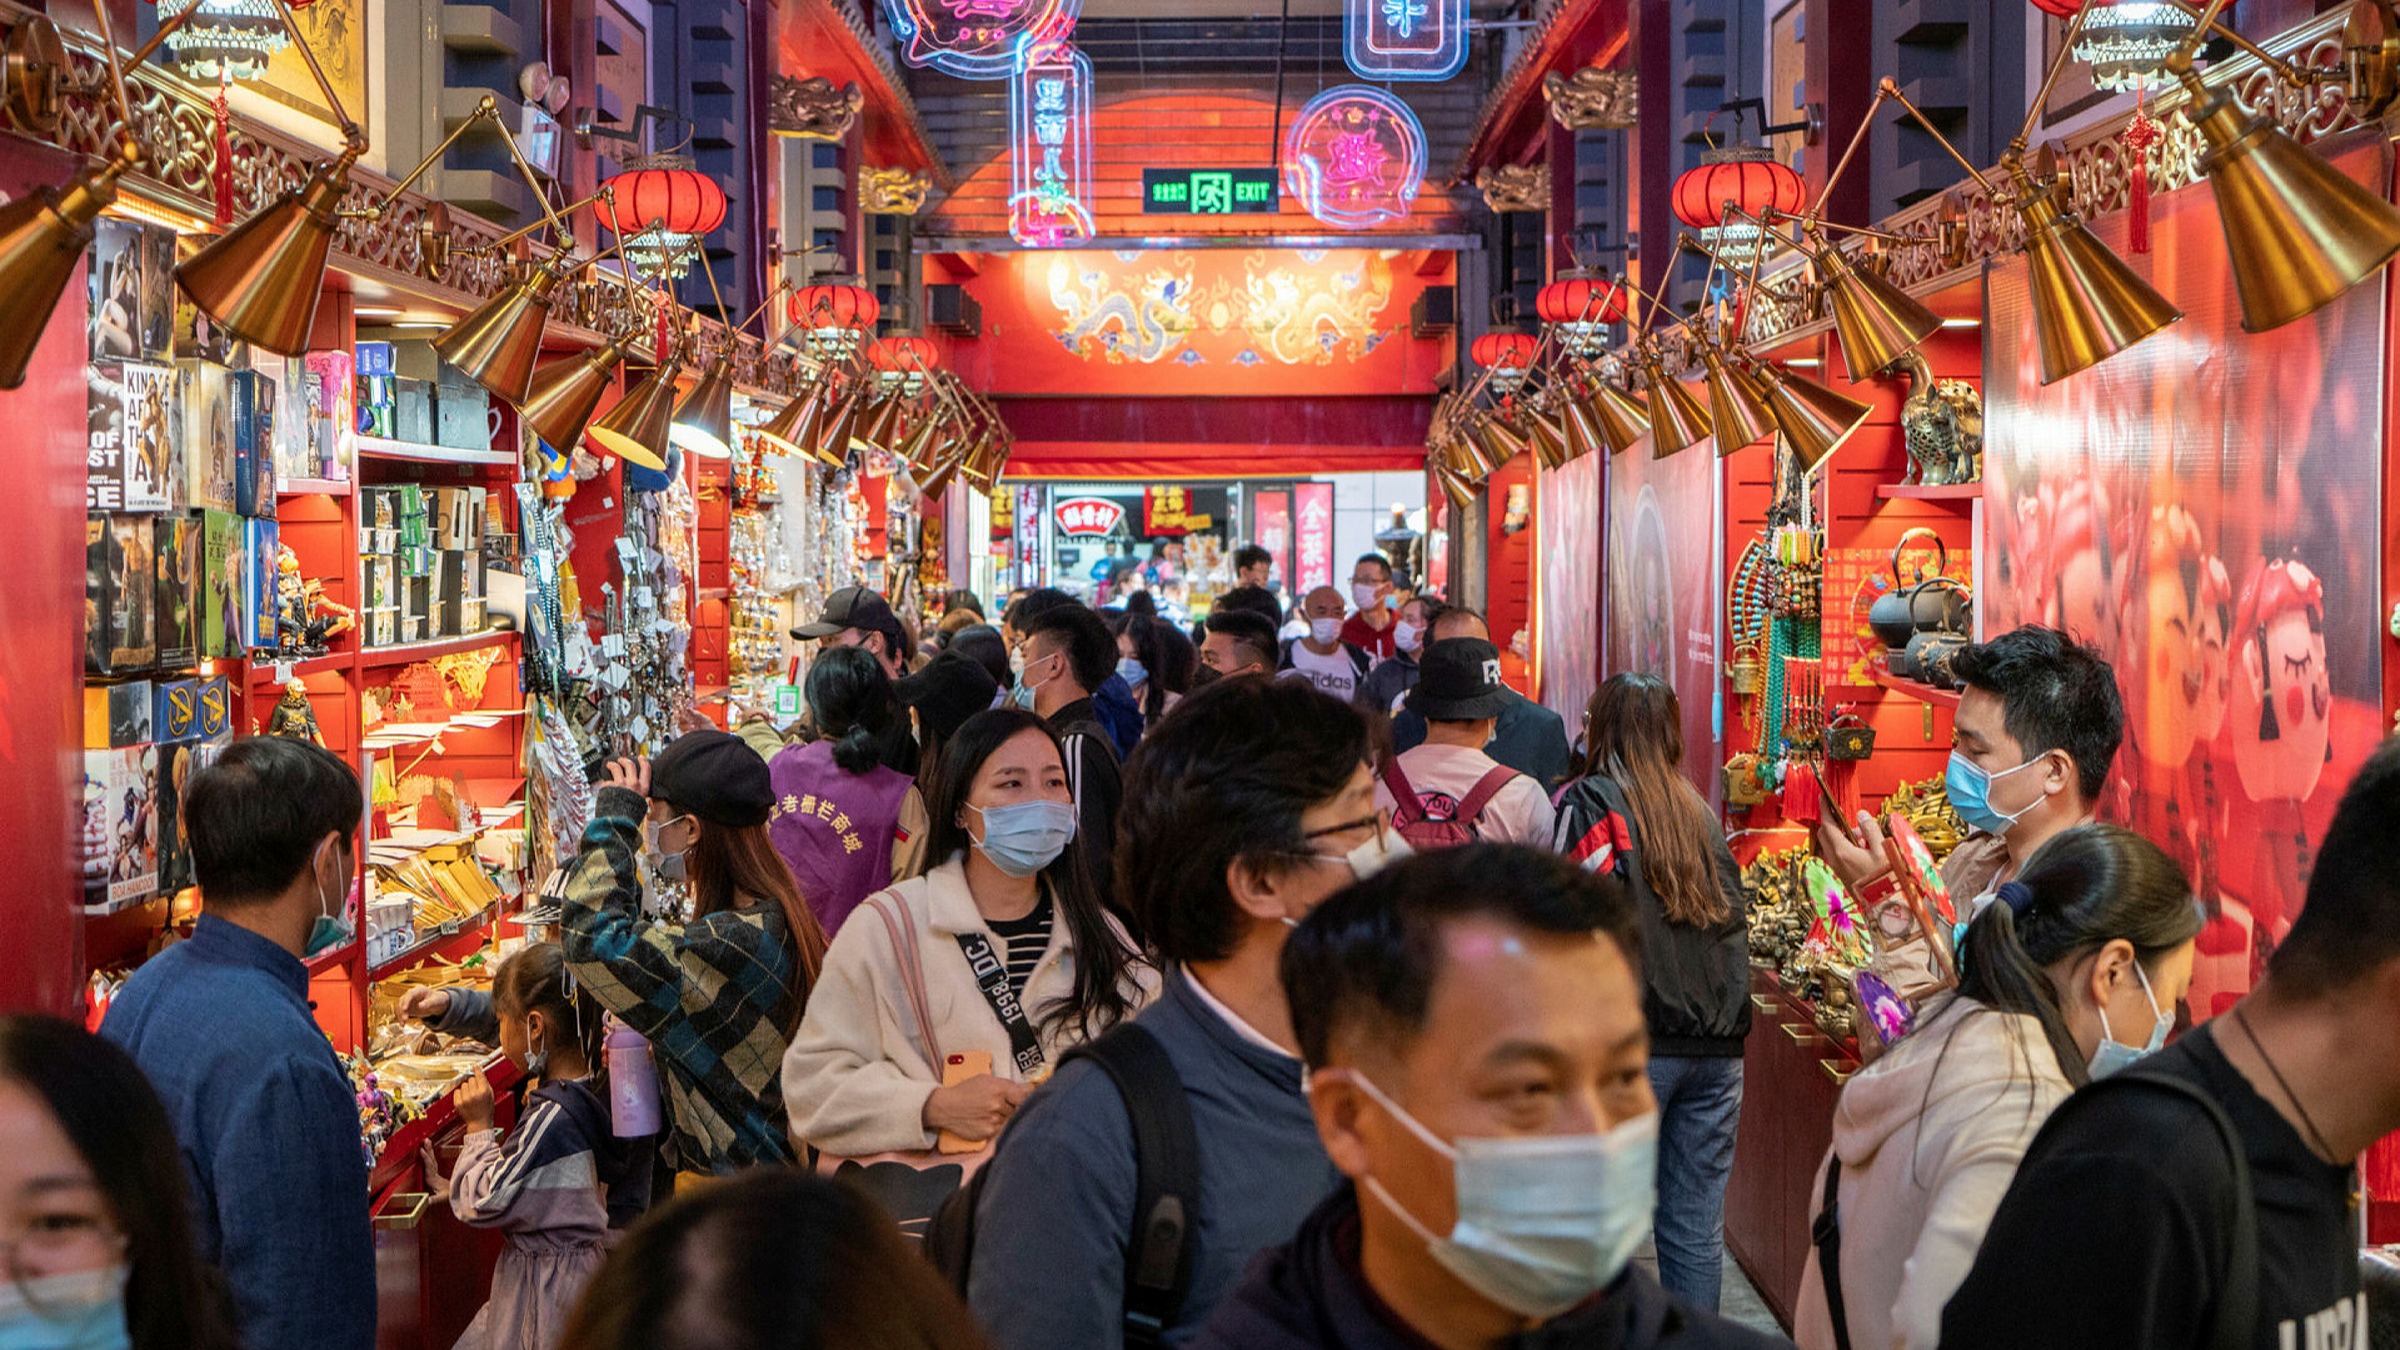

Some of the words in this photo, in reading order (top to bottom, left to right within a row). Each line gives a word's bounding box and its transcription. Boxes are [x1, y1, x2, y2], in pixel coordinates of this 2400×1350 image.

[1236, 182, 1270, 202] EXIT
[91, 431, 120, 448] OF
[128, 426, 146, 448] TH
[88, 449, 120, 468] ST
[87, 486, 121, 508] CE
[1482, 658, 1501, 685] R
[1423, 796, 1452, 812] YOU
[1017, 1050, 1033, 1071] ED
[1027, 1043, 1043, 1065] ON
